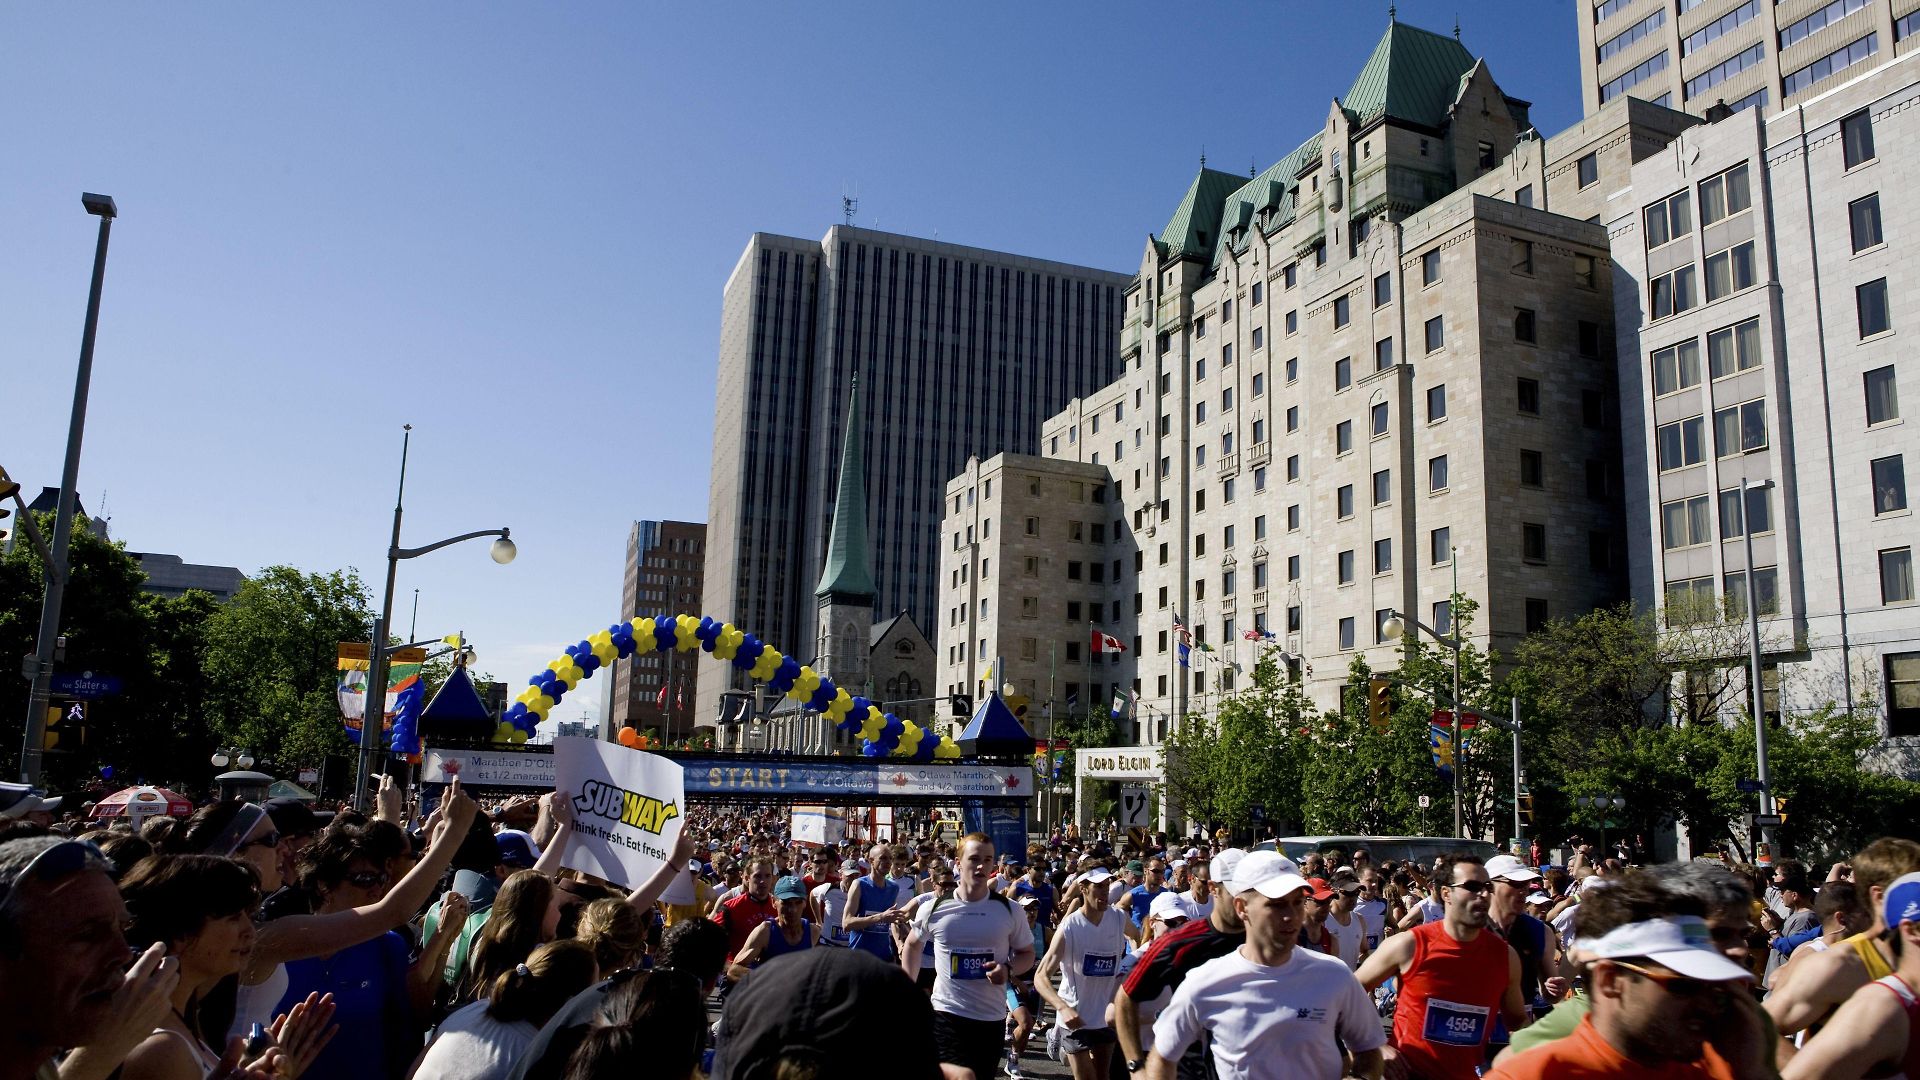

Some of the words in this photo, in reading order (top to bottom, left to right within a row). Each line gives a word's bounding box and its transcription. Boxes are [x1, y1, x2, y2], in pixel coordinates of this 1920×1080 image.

[74, 679, 100, 690] Slater
[471, 756, 521, 768] Marathon
[478, 771, 489, 779] et
[493, 770, 510, 780] 1/2
[513, 772, 556, 781] maratho
[707, 767, 790, 788] START
[918, 770, 951, 780] Ottawa
[918, 782, 935, 791] and
[937, 782, 951, 791] 1/2
[954, 783, 995, 791] marathon
[572, 779, 679, 835] SUBWAY
[626, 836, 641, 852] Eat
[1094, 959, 1113, 969] 4713
[1445, 1016, 1477, 1032] 4564
